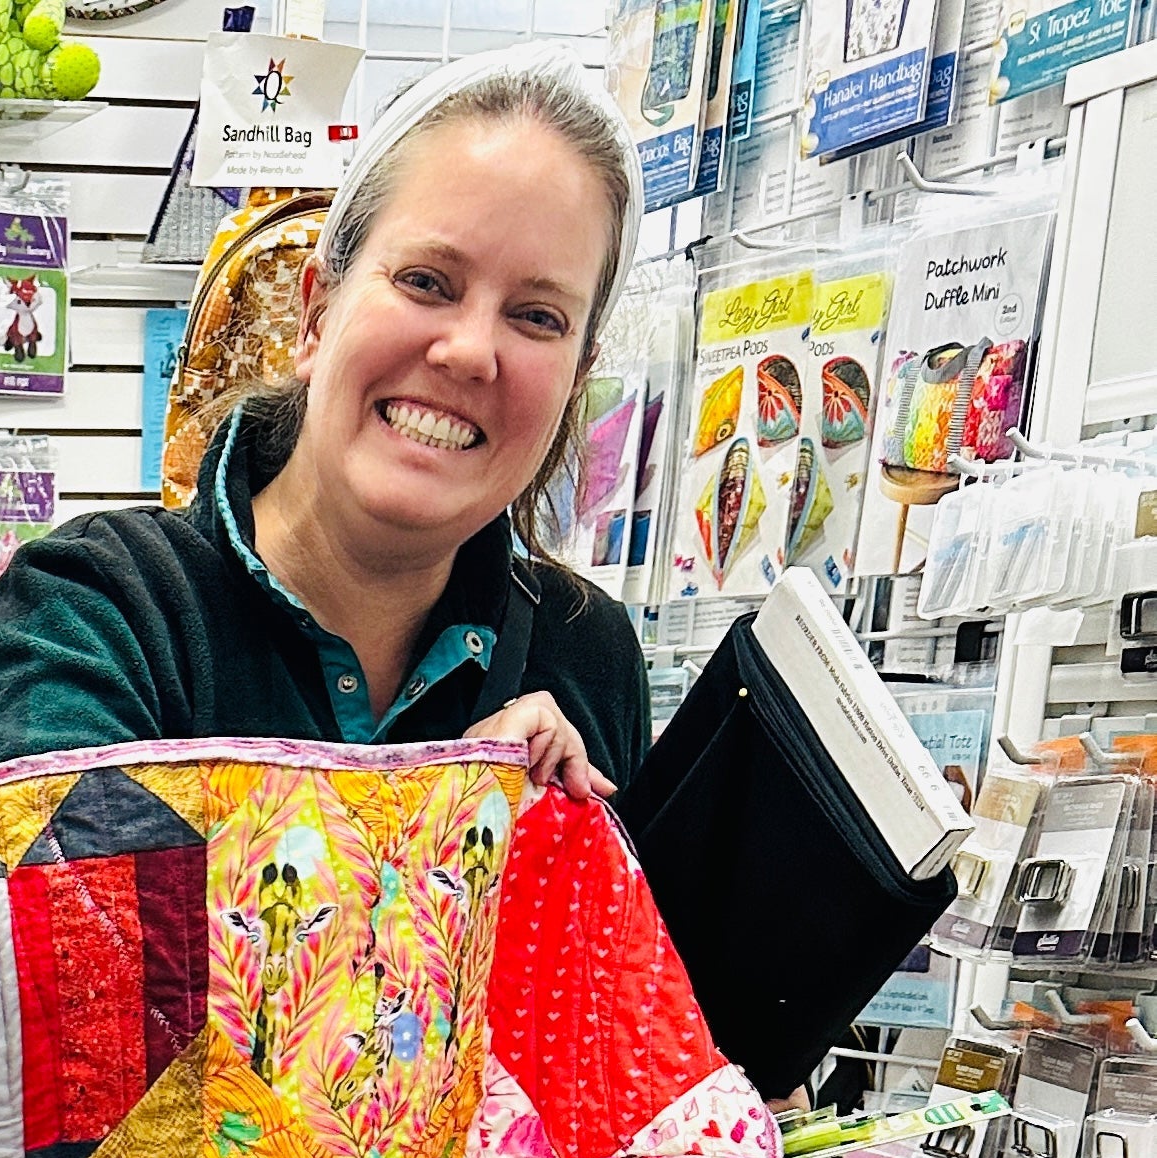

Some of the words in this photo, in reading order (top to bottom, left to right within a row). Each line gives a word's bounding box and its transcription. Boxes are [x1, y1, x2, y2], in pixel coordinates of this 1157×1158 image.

[1047, 6, 1091, 38] Tropez
[823, 81, 864, 109] Hanalei
[869, 61, 922, 92] Handbag
[222, 125, 280, 142] Sandhill
[284, 127, 312, 148] Bag
[674, 134, 692, 156] Bag
[226, 166, 246, 175] Made
[248, 166, 258, 176] by
[926, 247, 1007, 280] Patchwork
[924, 285, 969, 311] Duffle
[971, 282, 1000, 302] Mini
[719, 296, 758, 334] Lazy
[755, 287, 794, 329] Girl
[820, 290, 864, 331] Girl
[743, 340, 768, 356] PODS
[875, 739, 890, 758] Drive
[950, 735, 972, 749] Tote
